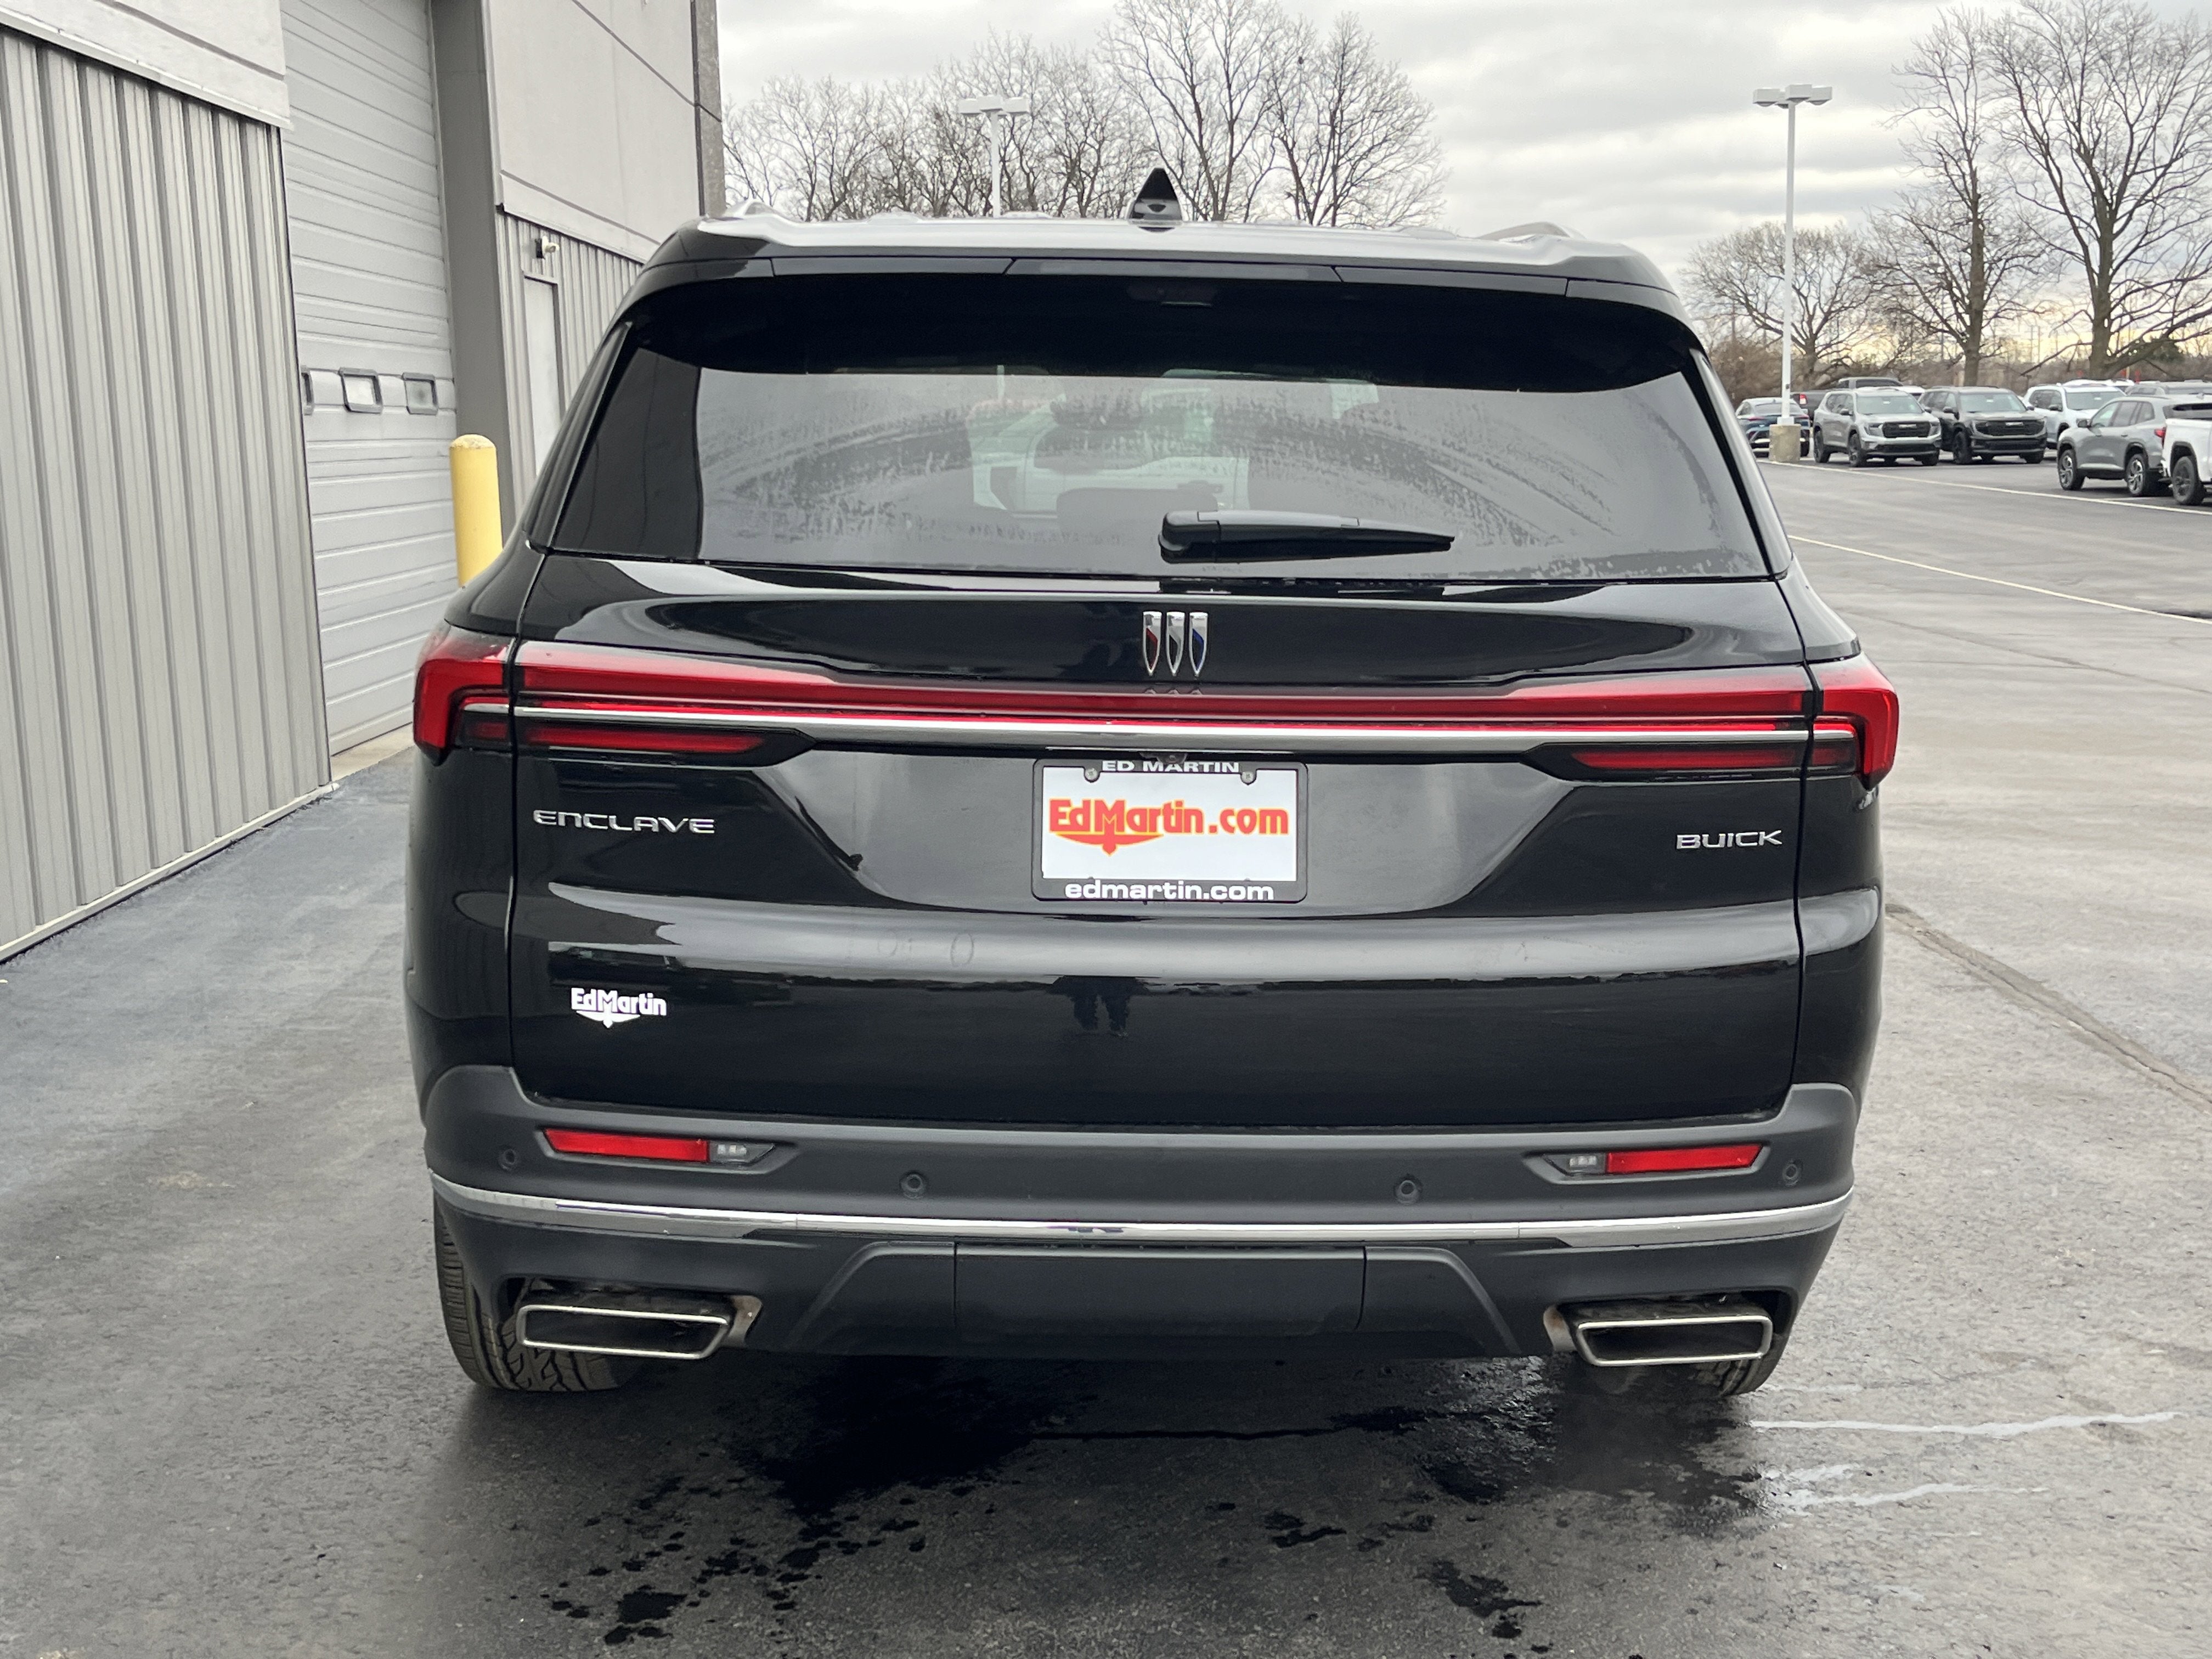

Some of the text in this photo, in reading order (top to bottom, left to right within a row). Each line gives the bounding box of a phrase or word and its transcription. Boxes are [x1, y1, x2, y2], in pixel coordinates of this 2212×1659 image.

[1102, 760, 1239, 773] ED MARTIN
[533, 809, 715, 833] ENCLAVE
[1048, 798, 1289, 836] EdMartin.com
[1676, 830, 1783, 849] BUICK
[1064, 879, 1274, 900] edmartin.com
[571, 987, 667, 1017] EdMartin
